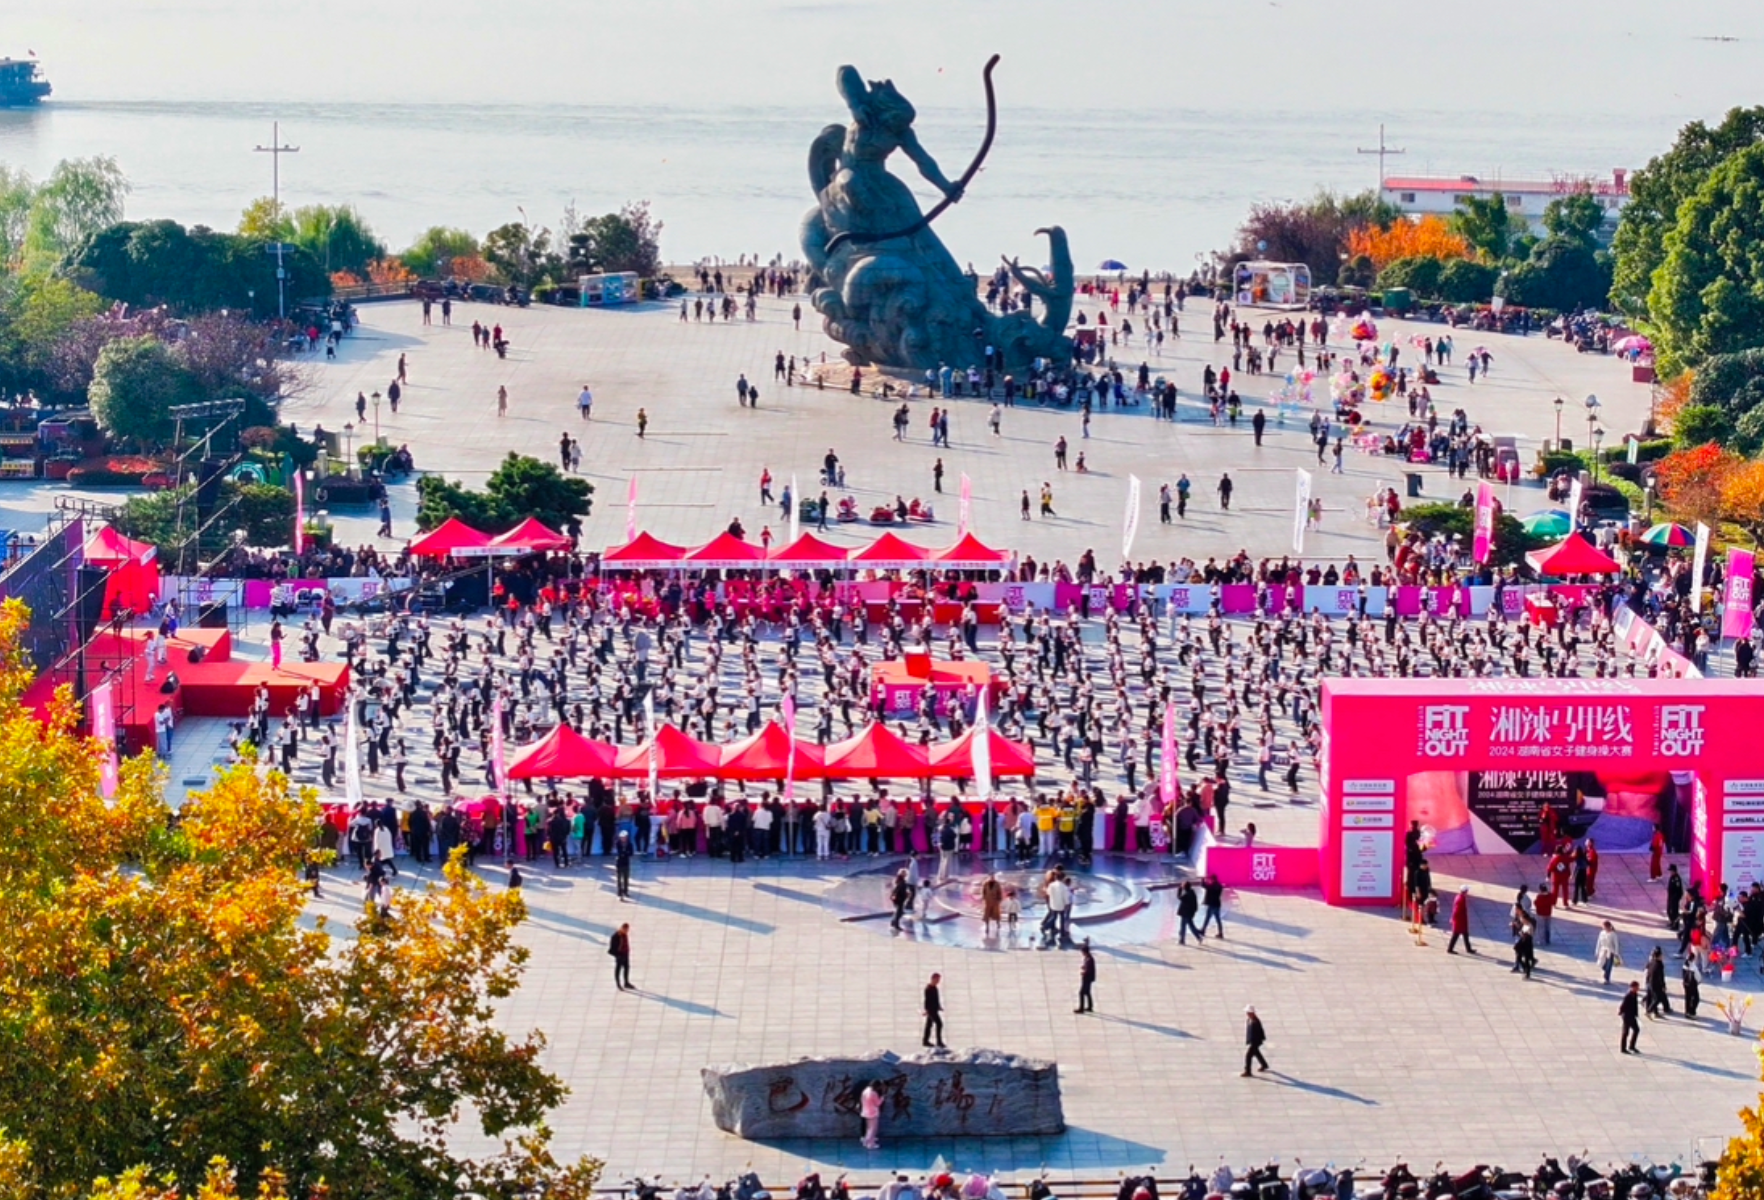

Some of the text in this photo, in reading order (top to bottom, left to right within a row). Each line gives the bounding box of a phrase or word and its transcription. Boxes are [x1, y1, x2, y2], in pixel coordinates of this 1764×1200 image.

[1425, 704, 1470, 728] FIT
[1489, 706, 1633, 742] 湘辣马甲线
[1661, 704, 1706, 728] FIT
[1425, 728, 1469, 741] NIGHT
[1661, 728, 1705, 741] NIGHT
[1424, 740, 1469, 757] OUT
[1489, 745, 1633, 758] 2024 湖南省女子健身操大赛
[1660, 740, 1705, 757] OUT
[1252, 852, 1276, 867] FIT
[1252, 871, 1276, 881] OUT
